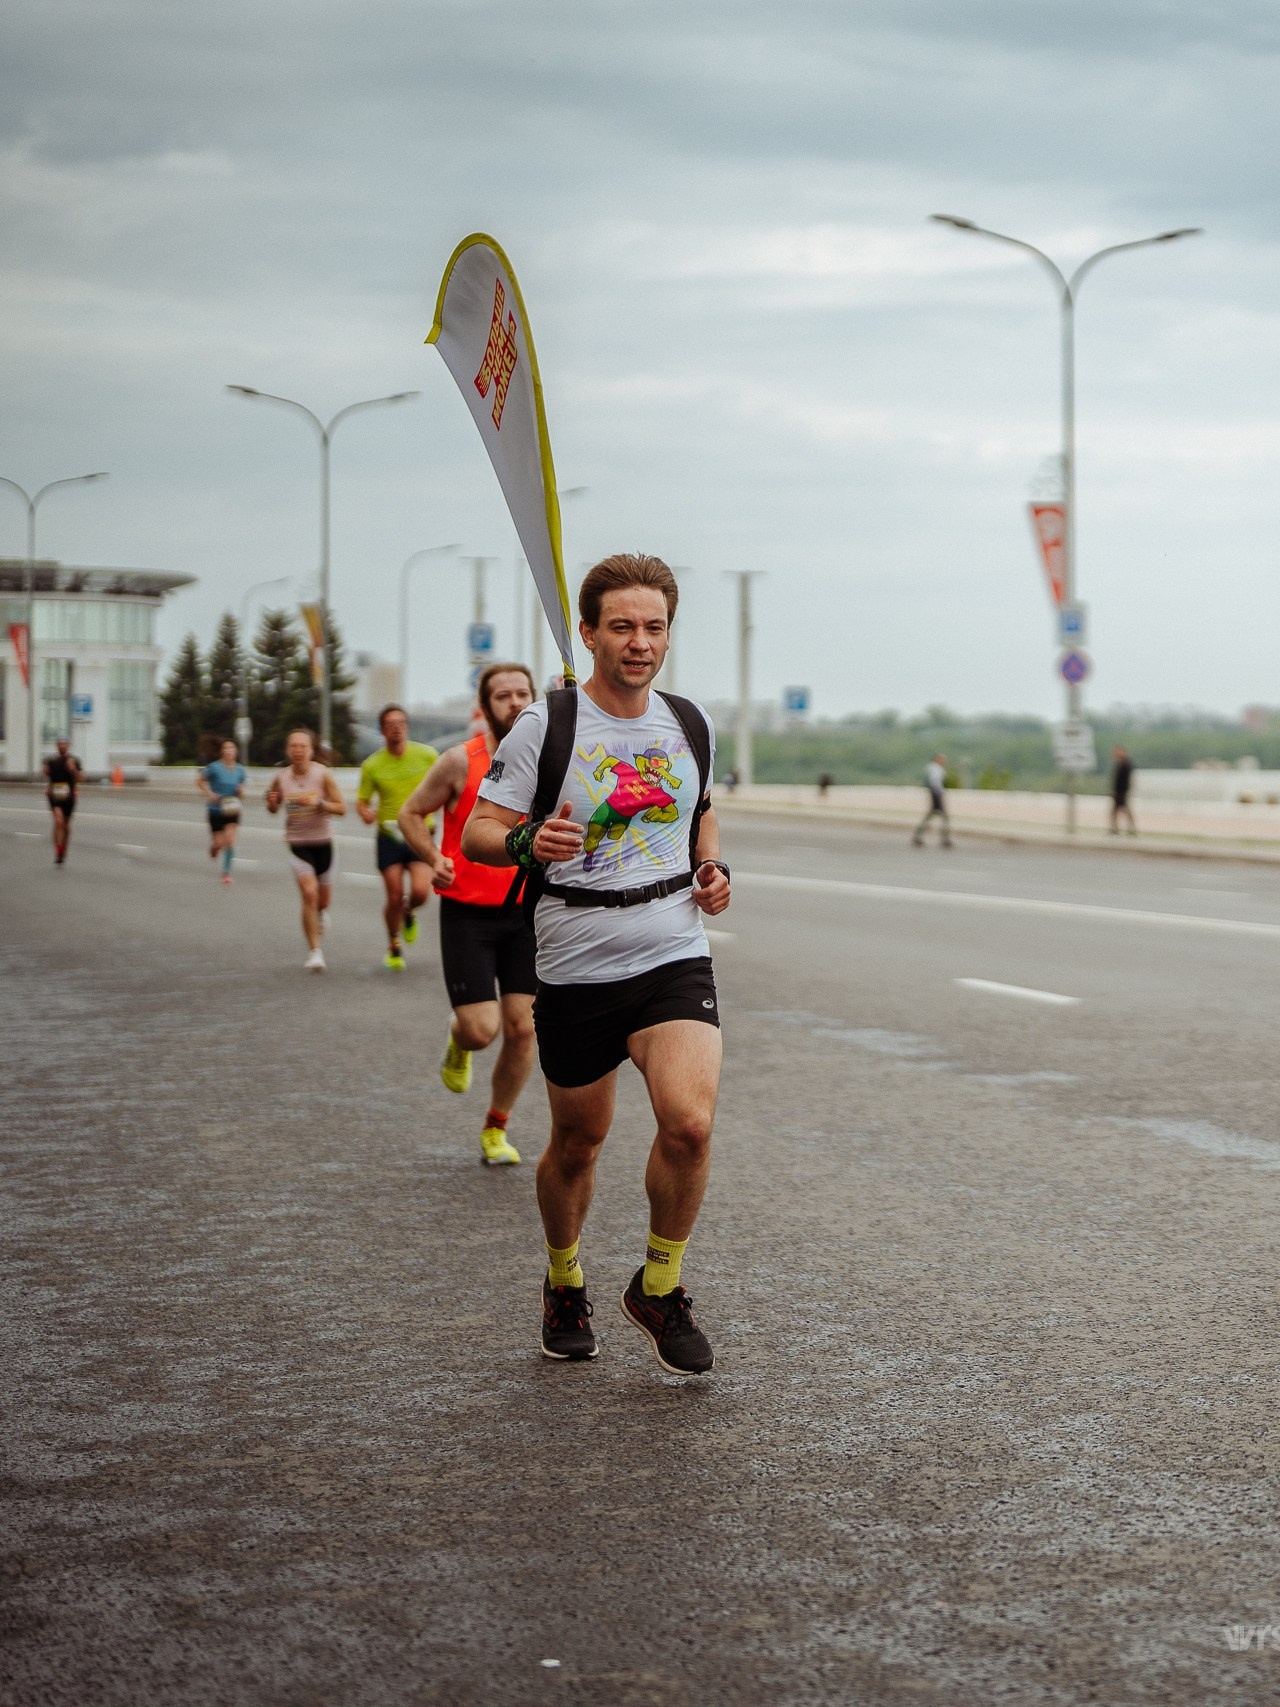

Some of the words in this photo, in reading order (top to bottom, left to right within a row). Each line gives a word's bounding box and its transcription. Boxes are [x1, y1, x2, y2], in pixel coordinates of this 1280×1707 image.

[479, 280, 504, 389] БОЛЬШЕ
[493, 324, 508, 378] ЧЕМ
[494, 320, 517, 428] МОЖЕШЬ
